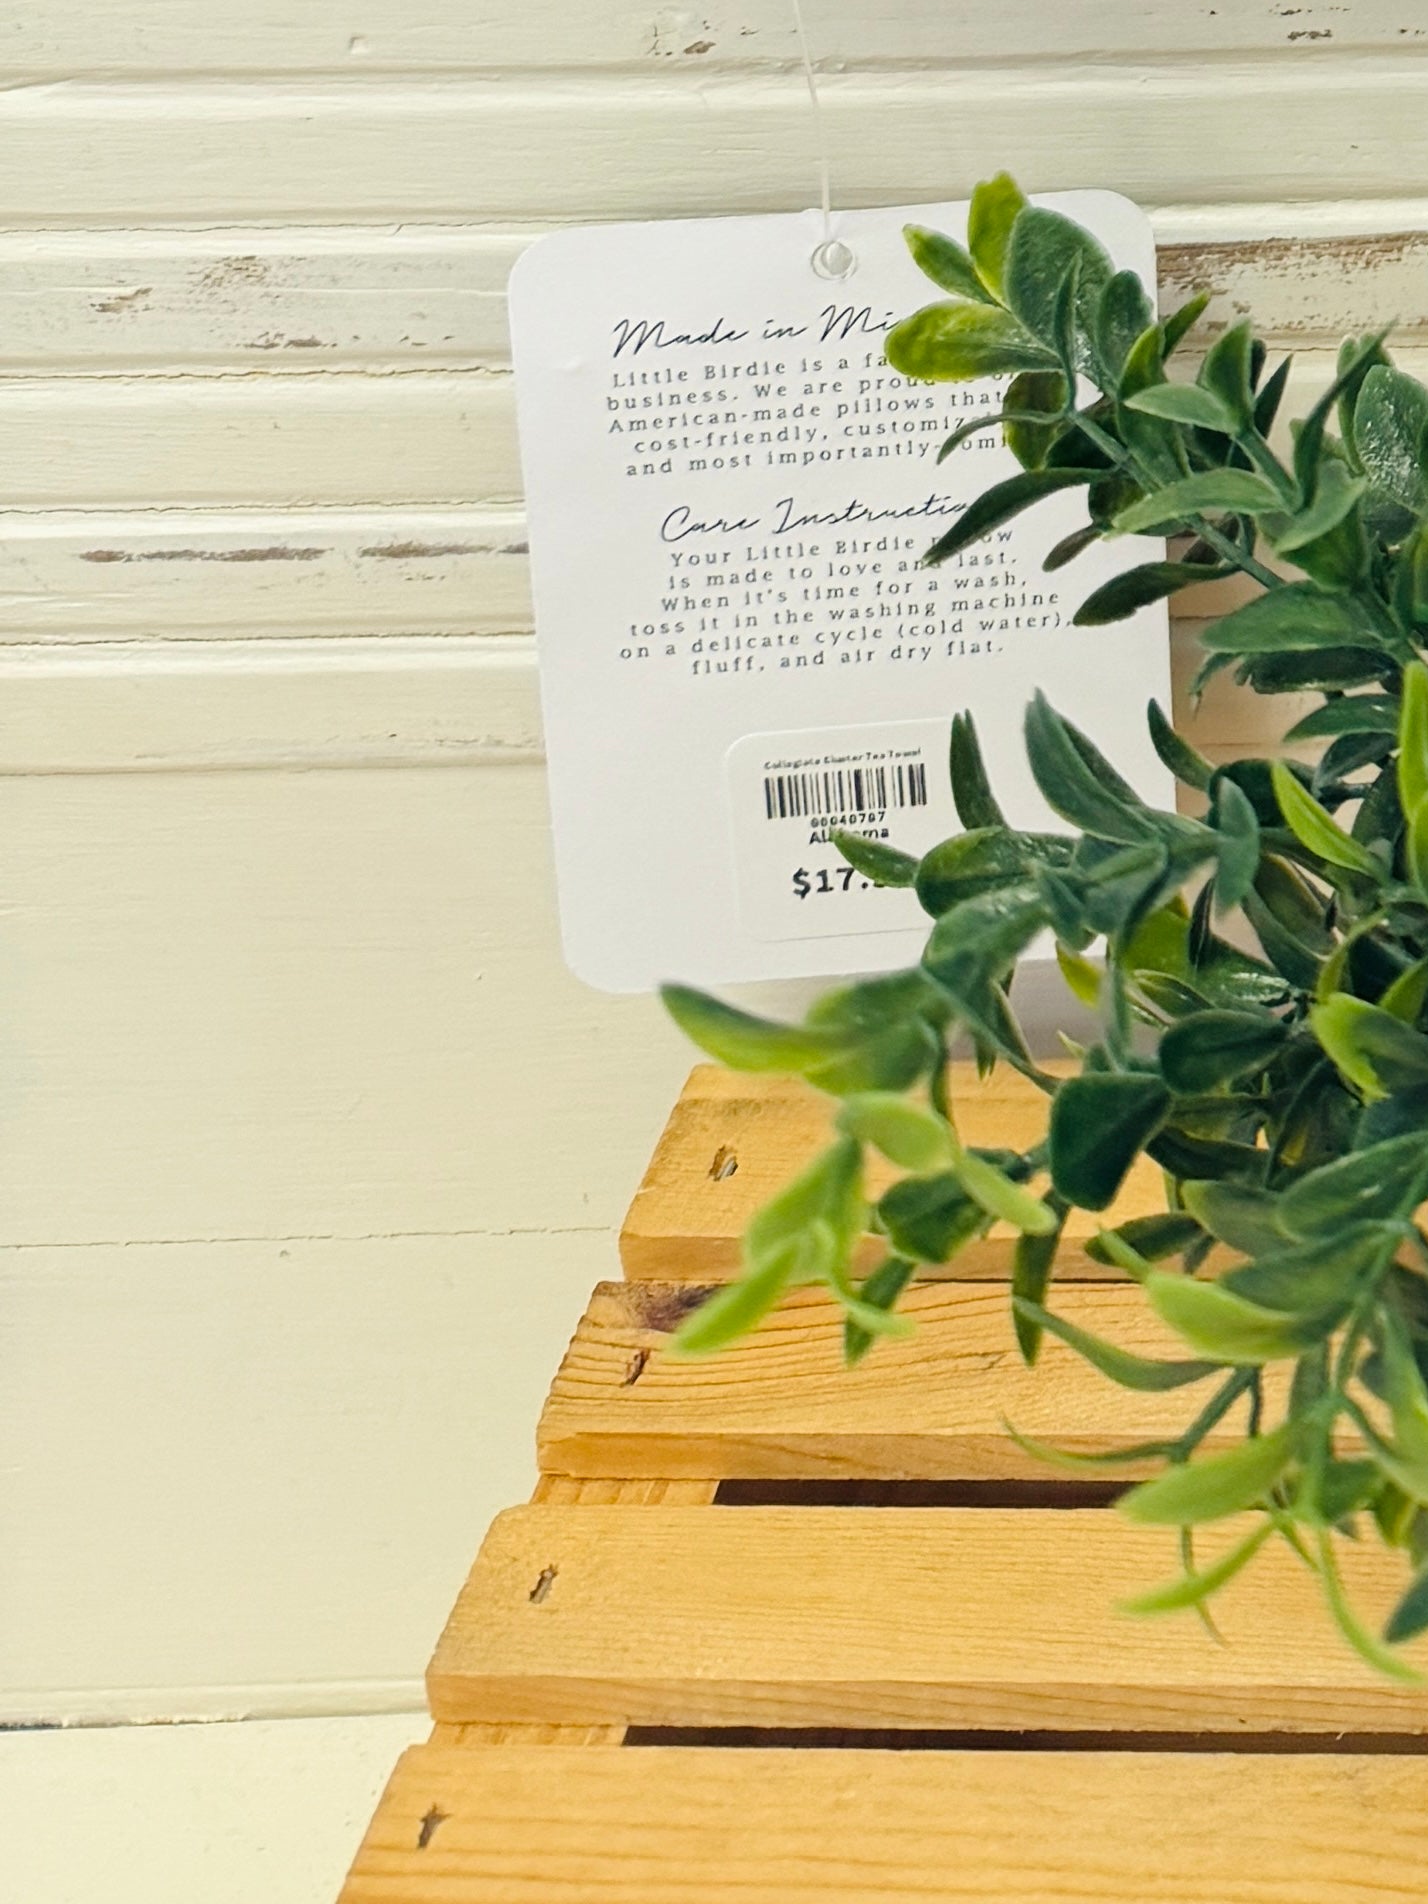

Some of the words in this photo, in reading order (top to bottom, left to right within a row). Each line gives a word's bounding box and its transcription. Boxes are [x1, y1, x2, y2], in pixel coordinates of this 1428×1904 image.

[613, 317, 749, 358] Made
[762, 318, 808, 340] in
[613, 368, 689, 389] Little
[704, 360, 787, 381] Birdie
[801, 357, 824, 373] is
[838, 358, 850, 370] a
[606, 388, 740, 412] business.
[754, 383, 788, 399] We
[803, 380, 844, 395] are
[608, 402, 822, 434] American-made
[837, 395, 936, 419] pillows
[950, 390, 1005, 407] that
[634, 424, 829, 454] cost-friendly,
[626, 457, 674, 477] and
[688, 453, 752, 472] most
[660, 505, 761, 543] Care
[670, 550, 732, 568] Your
[746, 541, 822, 562] Little
[835, 536, 915, 555] Birdie
[668, 575, 691, 590] is
[706, 568, 774, 587] made
[789, 566, 814, 580] to
[828, 561, 883, 578] love
[661, 592, 731, 613] When
[744, 588, 789, 606] it's
[803, 584, 861, 601] time
[875, 579, 915, 596] for
[927, 579, 940, 592] a
[954, 571, 1028, 590] wash,
[630, 619, 687, 637] toss
[699, 616, 720, 632] it
[734, 613, 759, 629] in
[773, 608, 815, 626] the
[828, 600, 938, 621] washing
[951, 591, 1061, 613] machine
[619, 646, 651, 661] on
[665, 643, 677, 656] a
[690, 632, 802, 655] delicate
[814, 625, 884, 647] cycle
[897, 618, 965, 640] (cold
[690, 654, 767, 676] fluff,
[779, 649, 826, 670] and
[840, 648, 877, 665] air
[890, 644, 934, 662] dry
